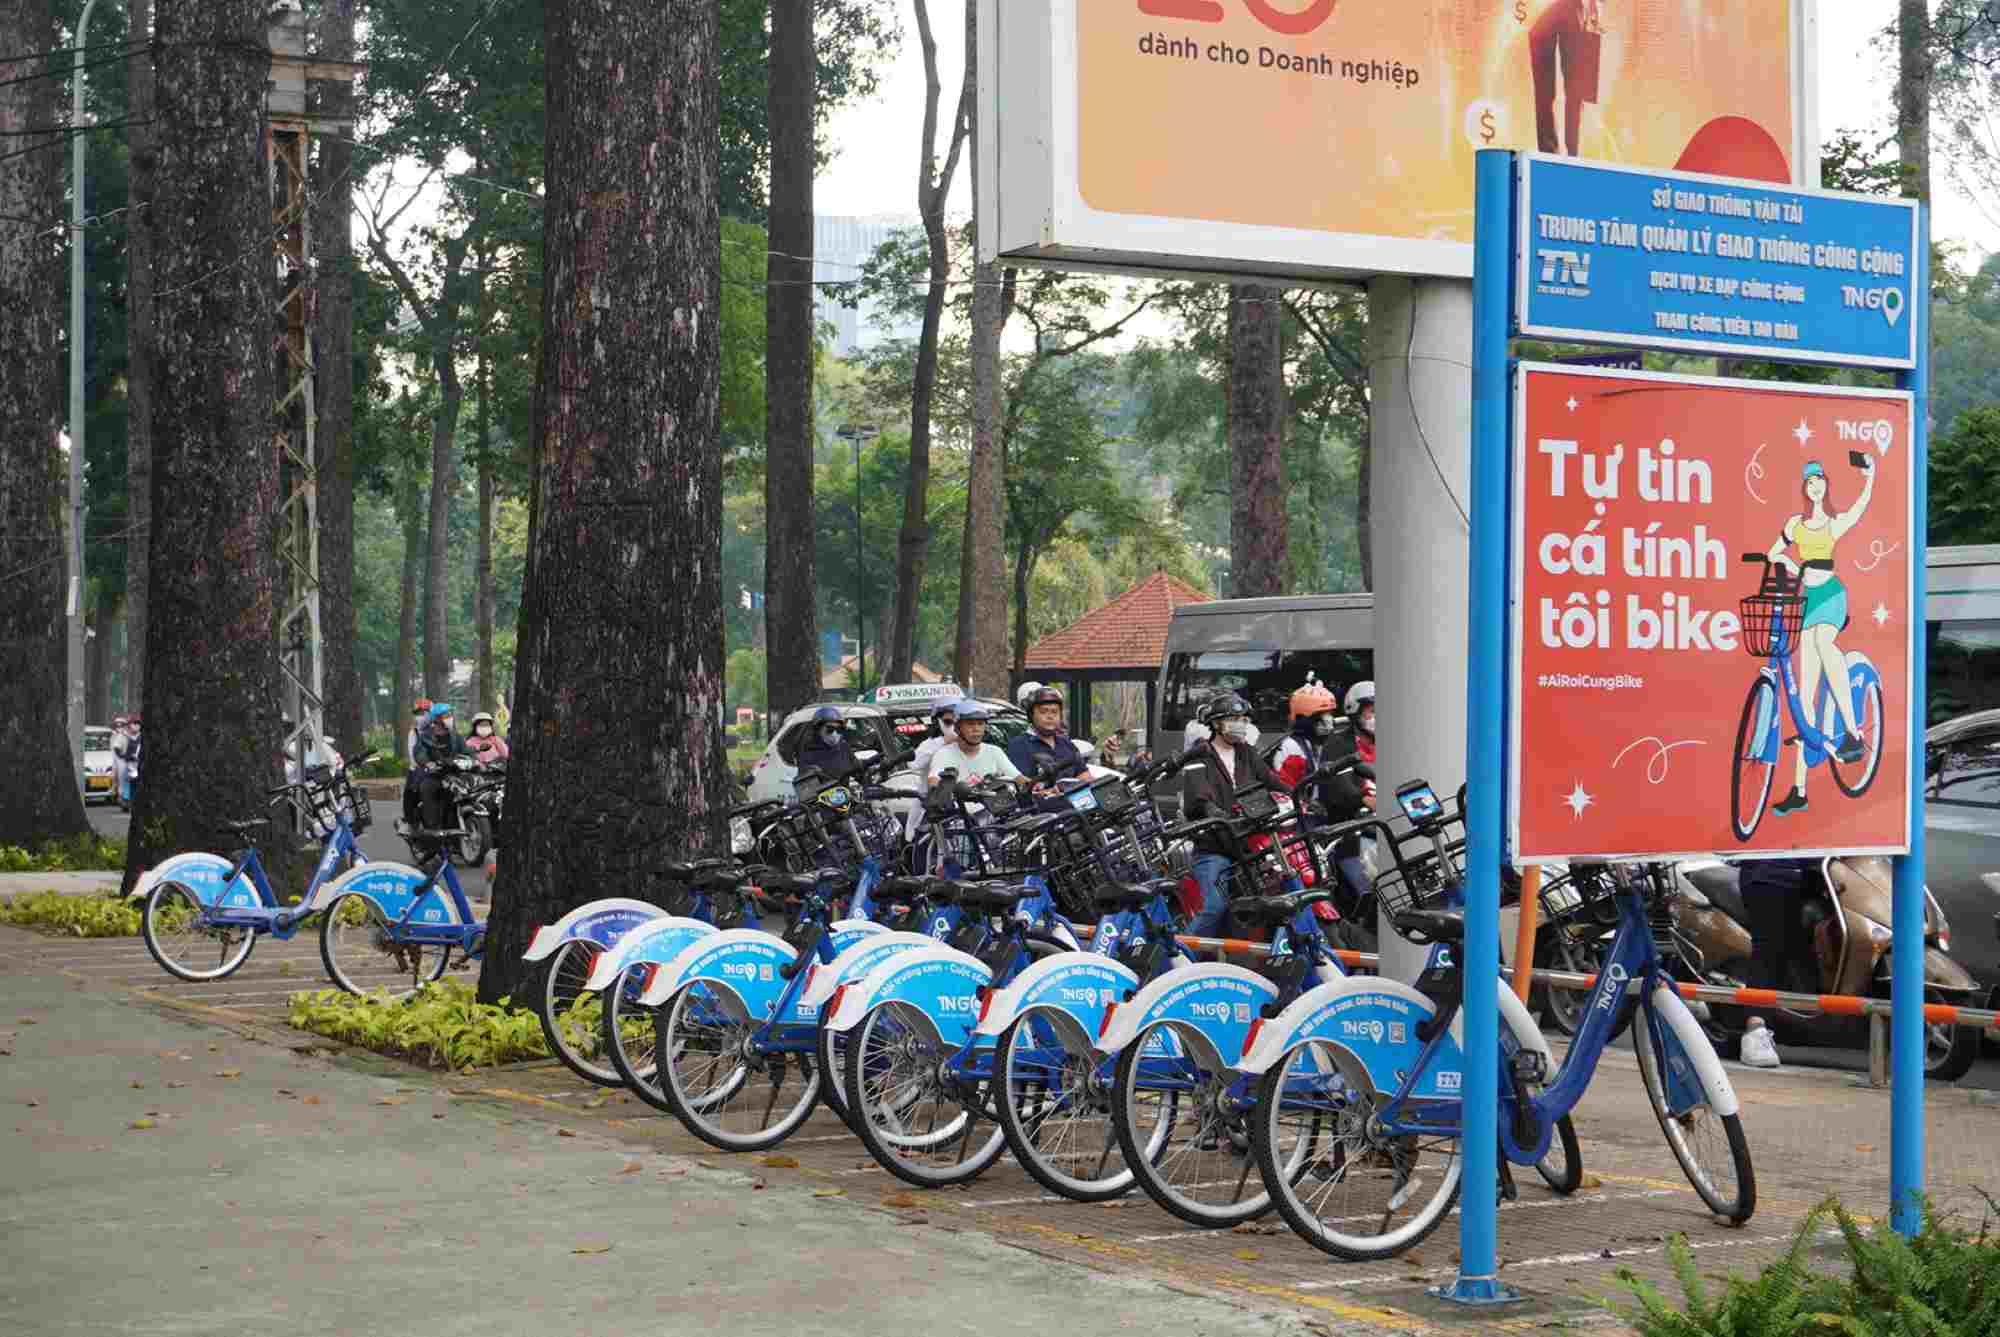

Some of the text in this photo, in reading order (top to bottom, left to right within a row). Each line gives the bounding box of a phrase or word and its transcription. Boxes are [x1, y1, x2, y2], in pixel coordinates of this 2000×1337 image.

[1138, 32, 1419, 89] dành cho Doanh nghiệp
[1674, 191, 1705, 212] GIAO
[1709, 193, 1751, 217] THÔNG
[1537, 213, 1905, 277] TRUNG TÂM QUẢN LÝ GIAO THÔNG CÔNG CỘNG
[1538, 438, 1713, 515] Tự tin
[1538, 520, 1727, 580] cá tính
[1540, 589, 1741, 651] tôi bike
[1537, 672, 1644, 691] #AiRoiCungBike
